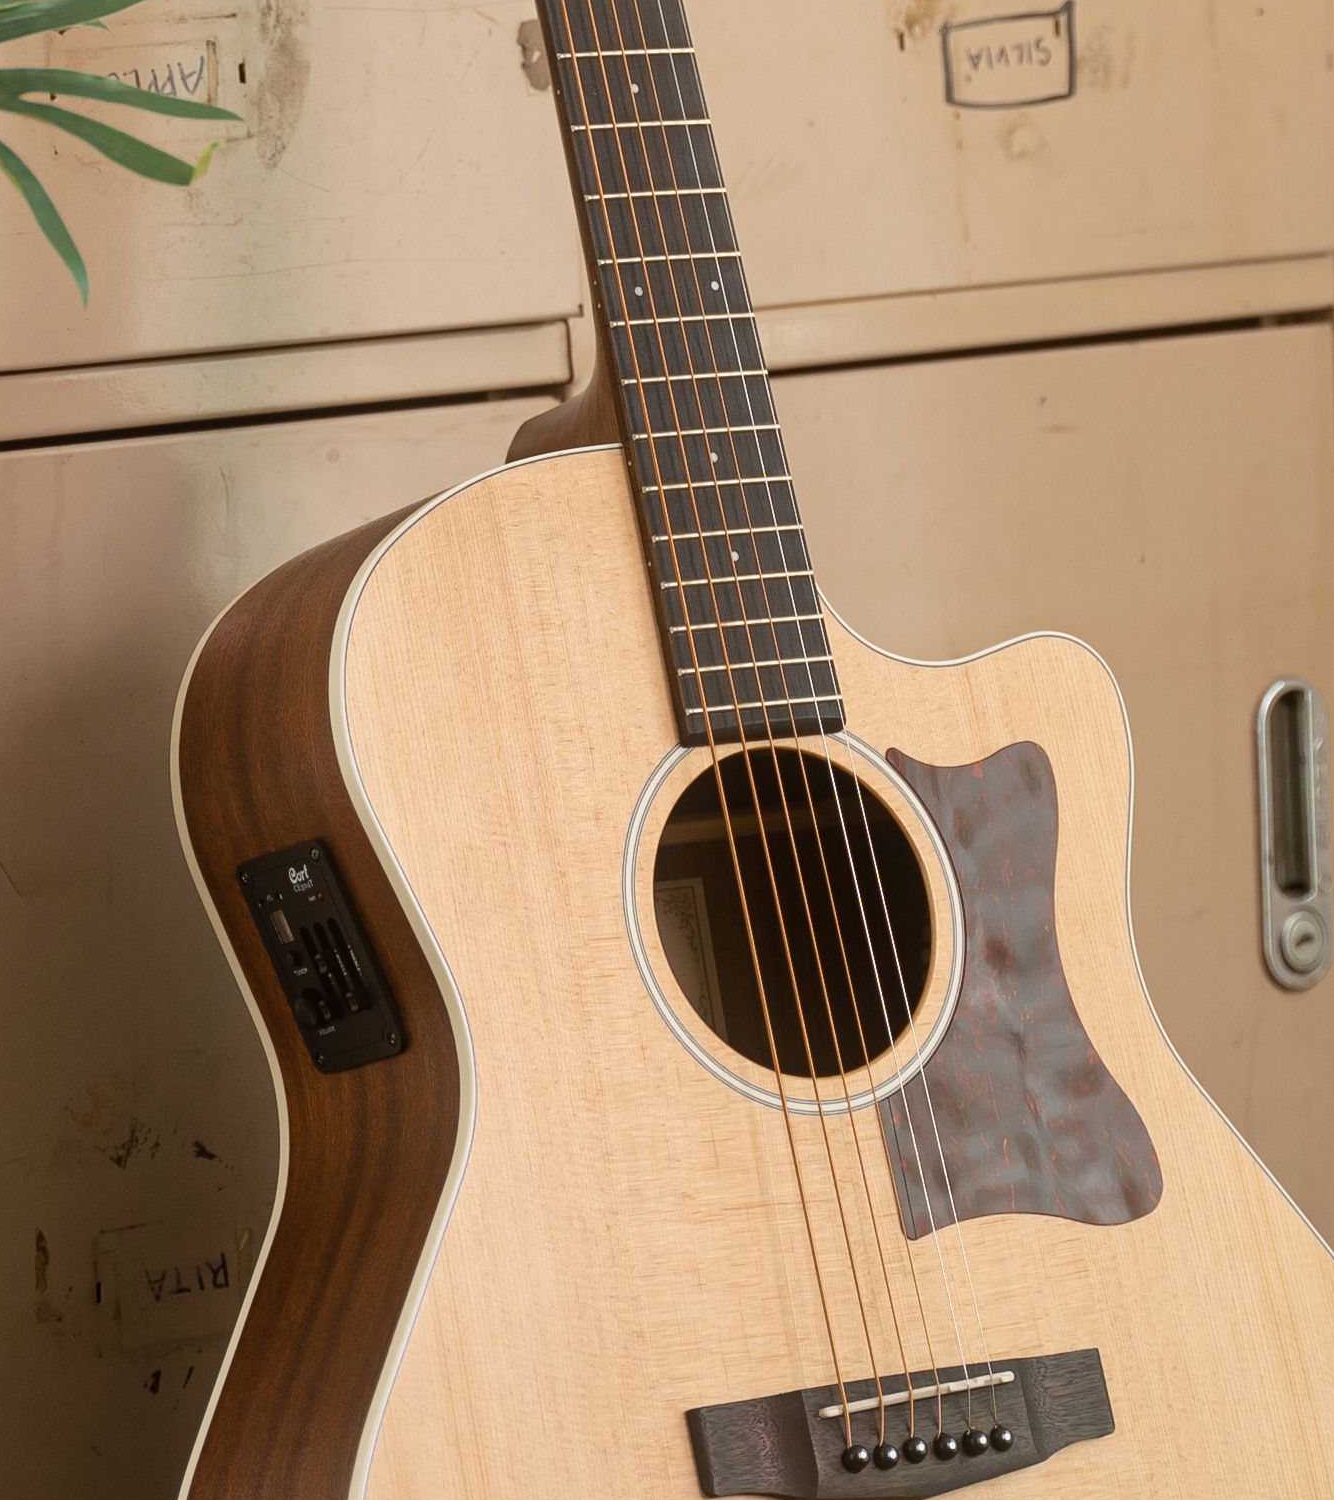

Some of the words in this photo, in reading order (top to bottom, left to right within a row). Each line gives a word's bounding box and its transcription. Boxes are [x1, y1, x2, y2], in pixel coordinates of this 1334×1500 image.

[966, 36, 1052, 71] SILVIA
[288, 863, 310, 884] Cort
[144, 1252, 230, 1303] RITA
